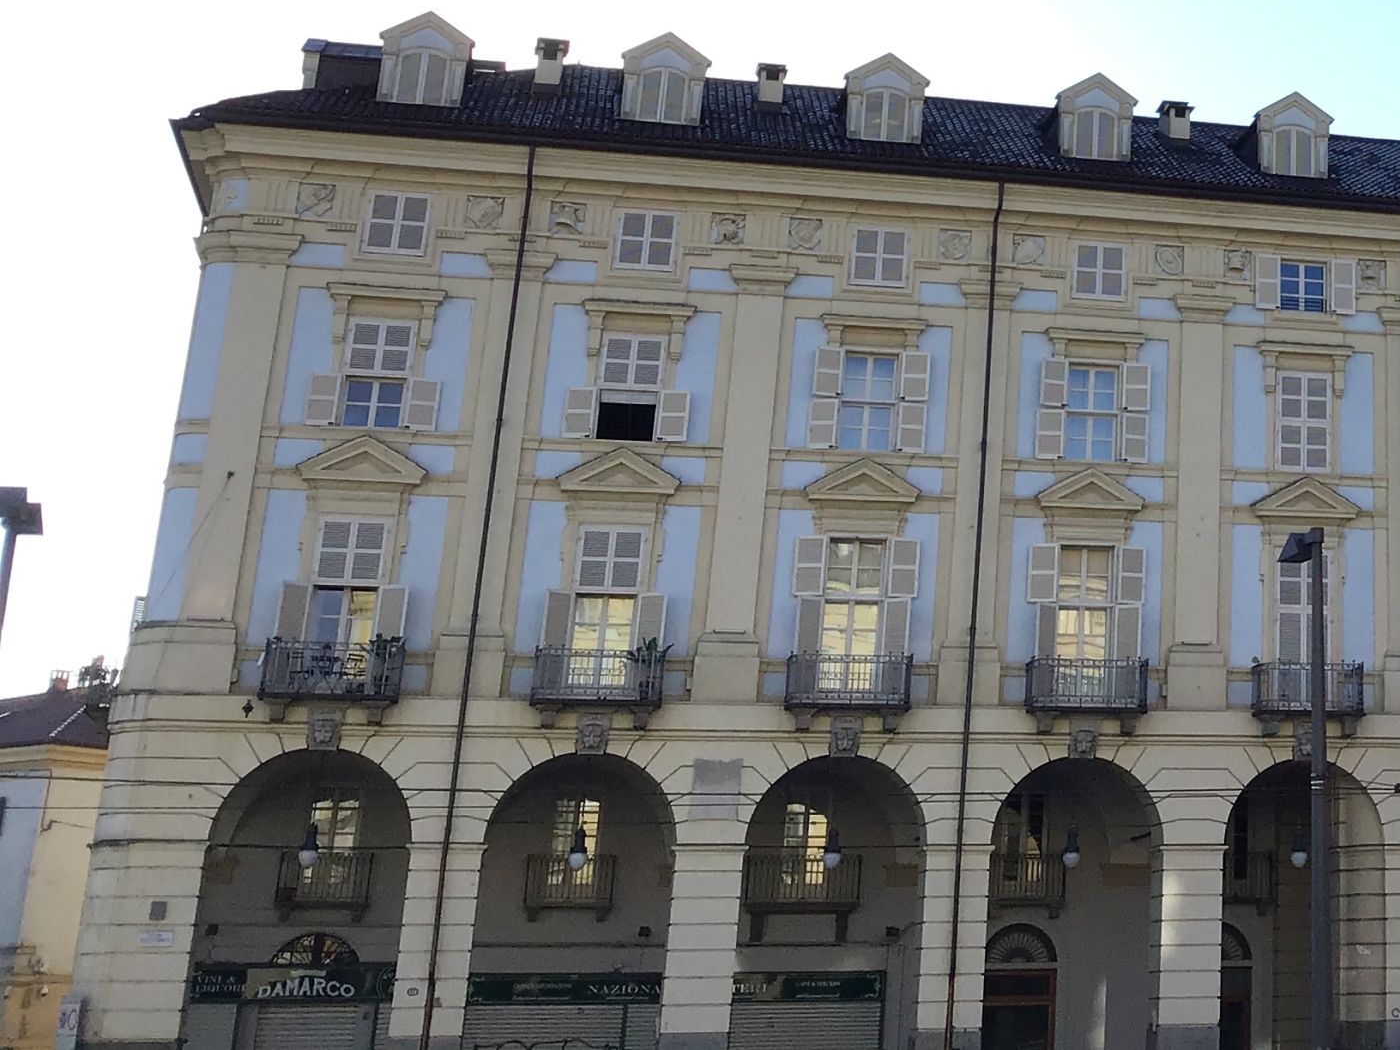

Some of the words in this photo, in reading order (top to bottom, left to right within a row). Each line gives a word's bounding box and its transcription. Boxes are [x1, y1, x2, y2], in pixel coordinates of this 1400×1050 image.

[197, 975, 222, 984] VINI
[226, 975, 238, 984] &
[195, 984, 246, 993] LIQUORI
[257, 977, 356, 998] DAMARCO
